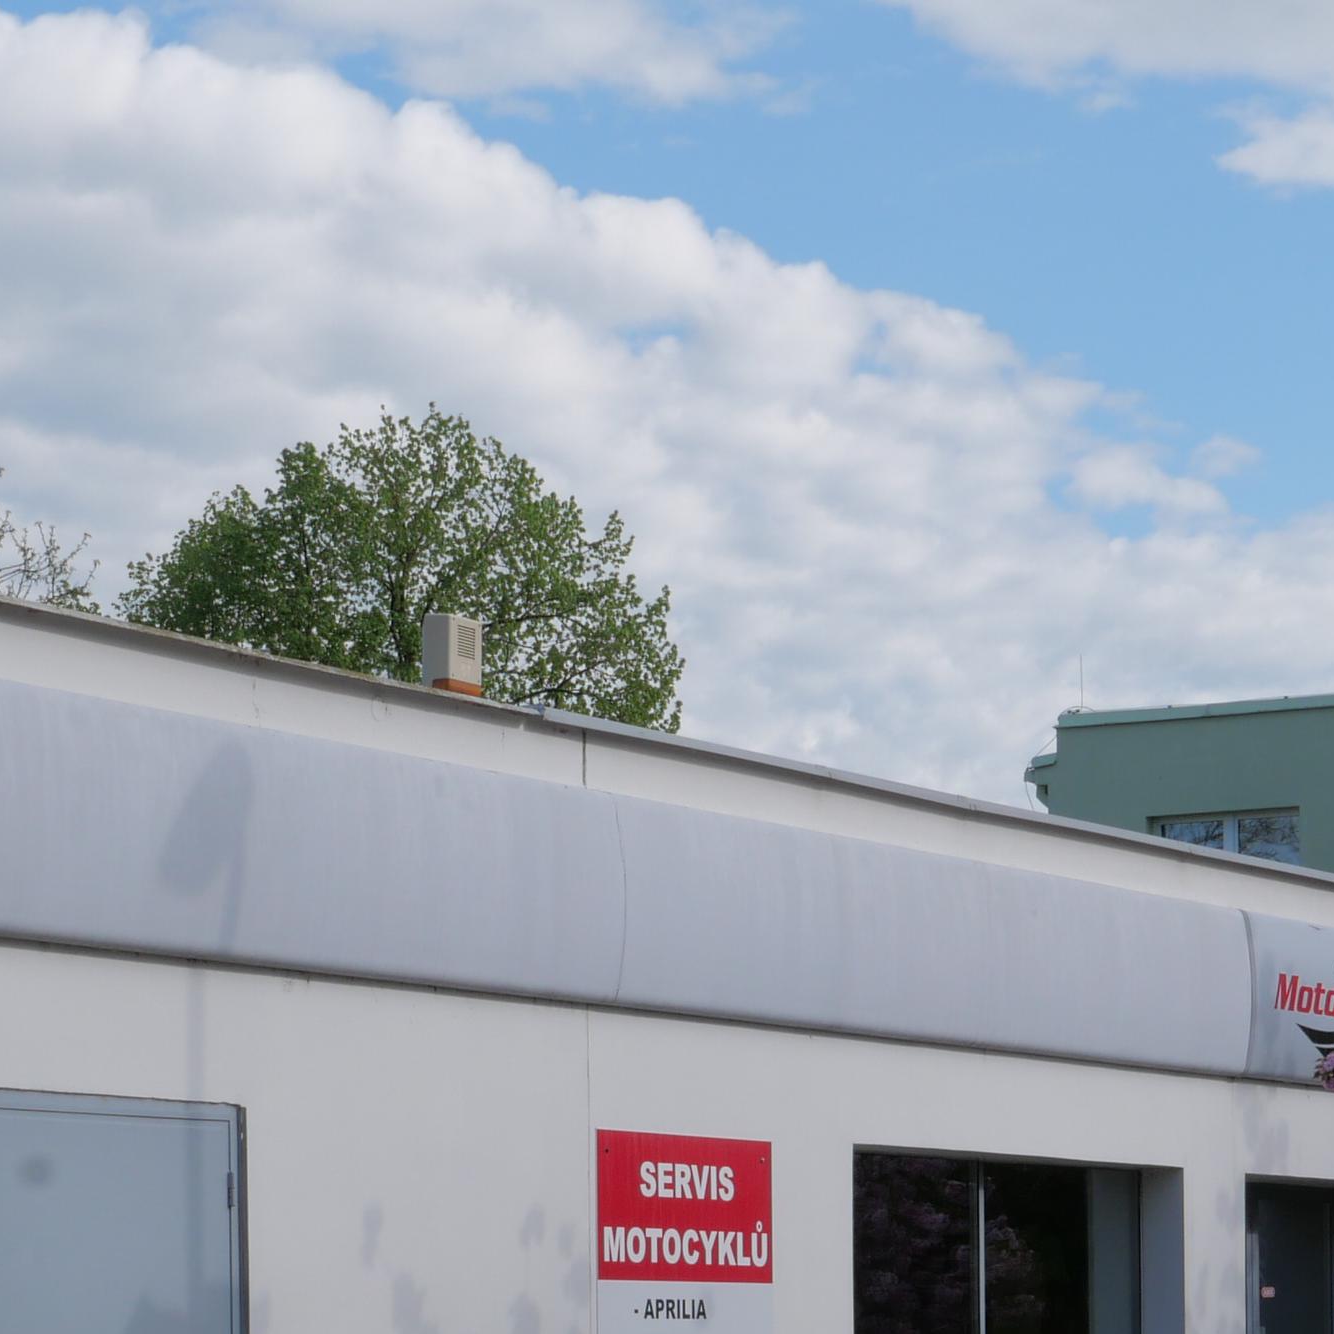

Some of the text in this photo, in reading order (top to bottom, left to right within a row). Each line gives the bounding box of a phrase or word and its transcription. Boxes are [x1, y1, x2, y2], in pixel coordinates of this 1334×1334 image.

[639, 1160, 735, 1201] SERVIS
[603, 1220, 768, 1267] MOTOCYKLŮ
[644, 1299, 707, 1319] APRILIA
